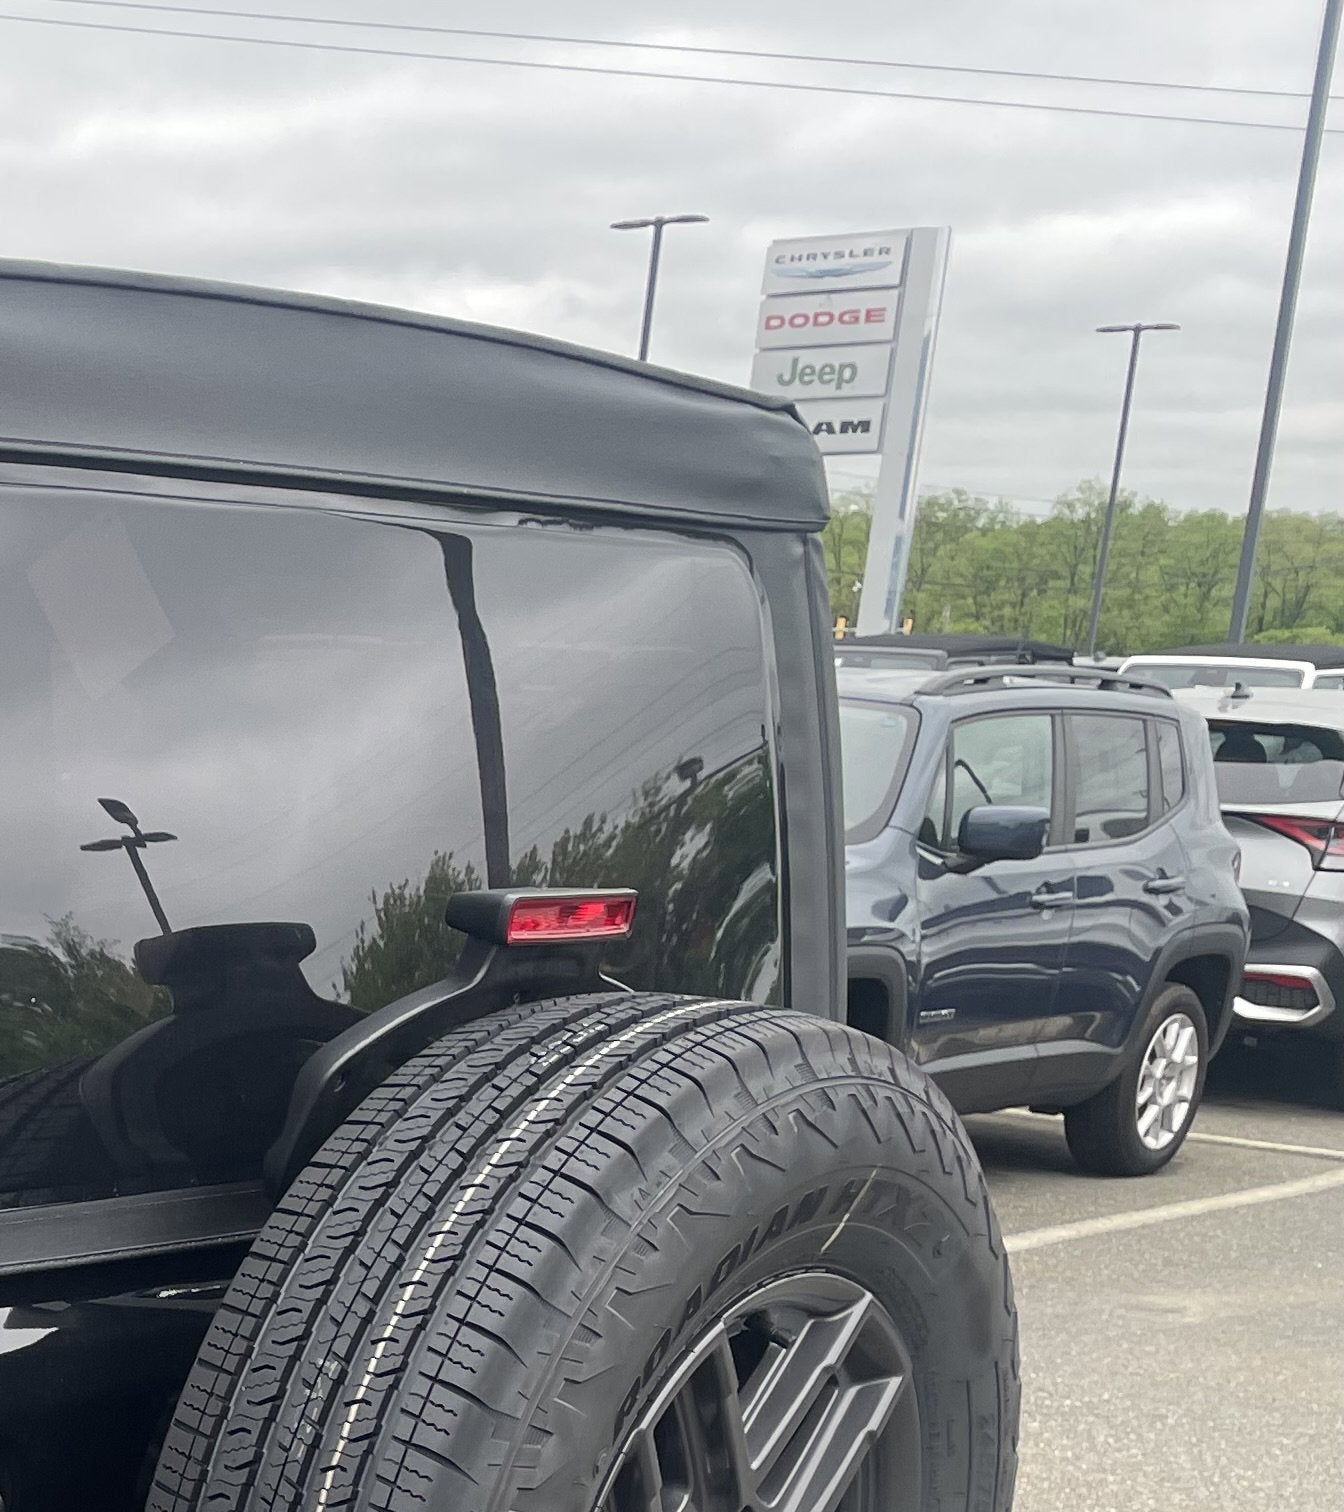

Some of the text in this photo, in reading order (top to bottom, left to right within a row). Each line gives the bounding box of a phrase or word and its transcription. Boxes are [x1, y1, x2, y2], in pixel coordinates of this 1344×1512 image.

[774, 246, 892, 265] CHRYSLER
[764, 306, 887, 331] DODGE
[777, 356, 858, 390] Jeep
[812, 419, 871, 436] AM
